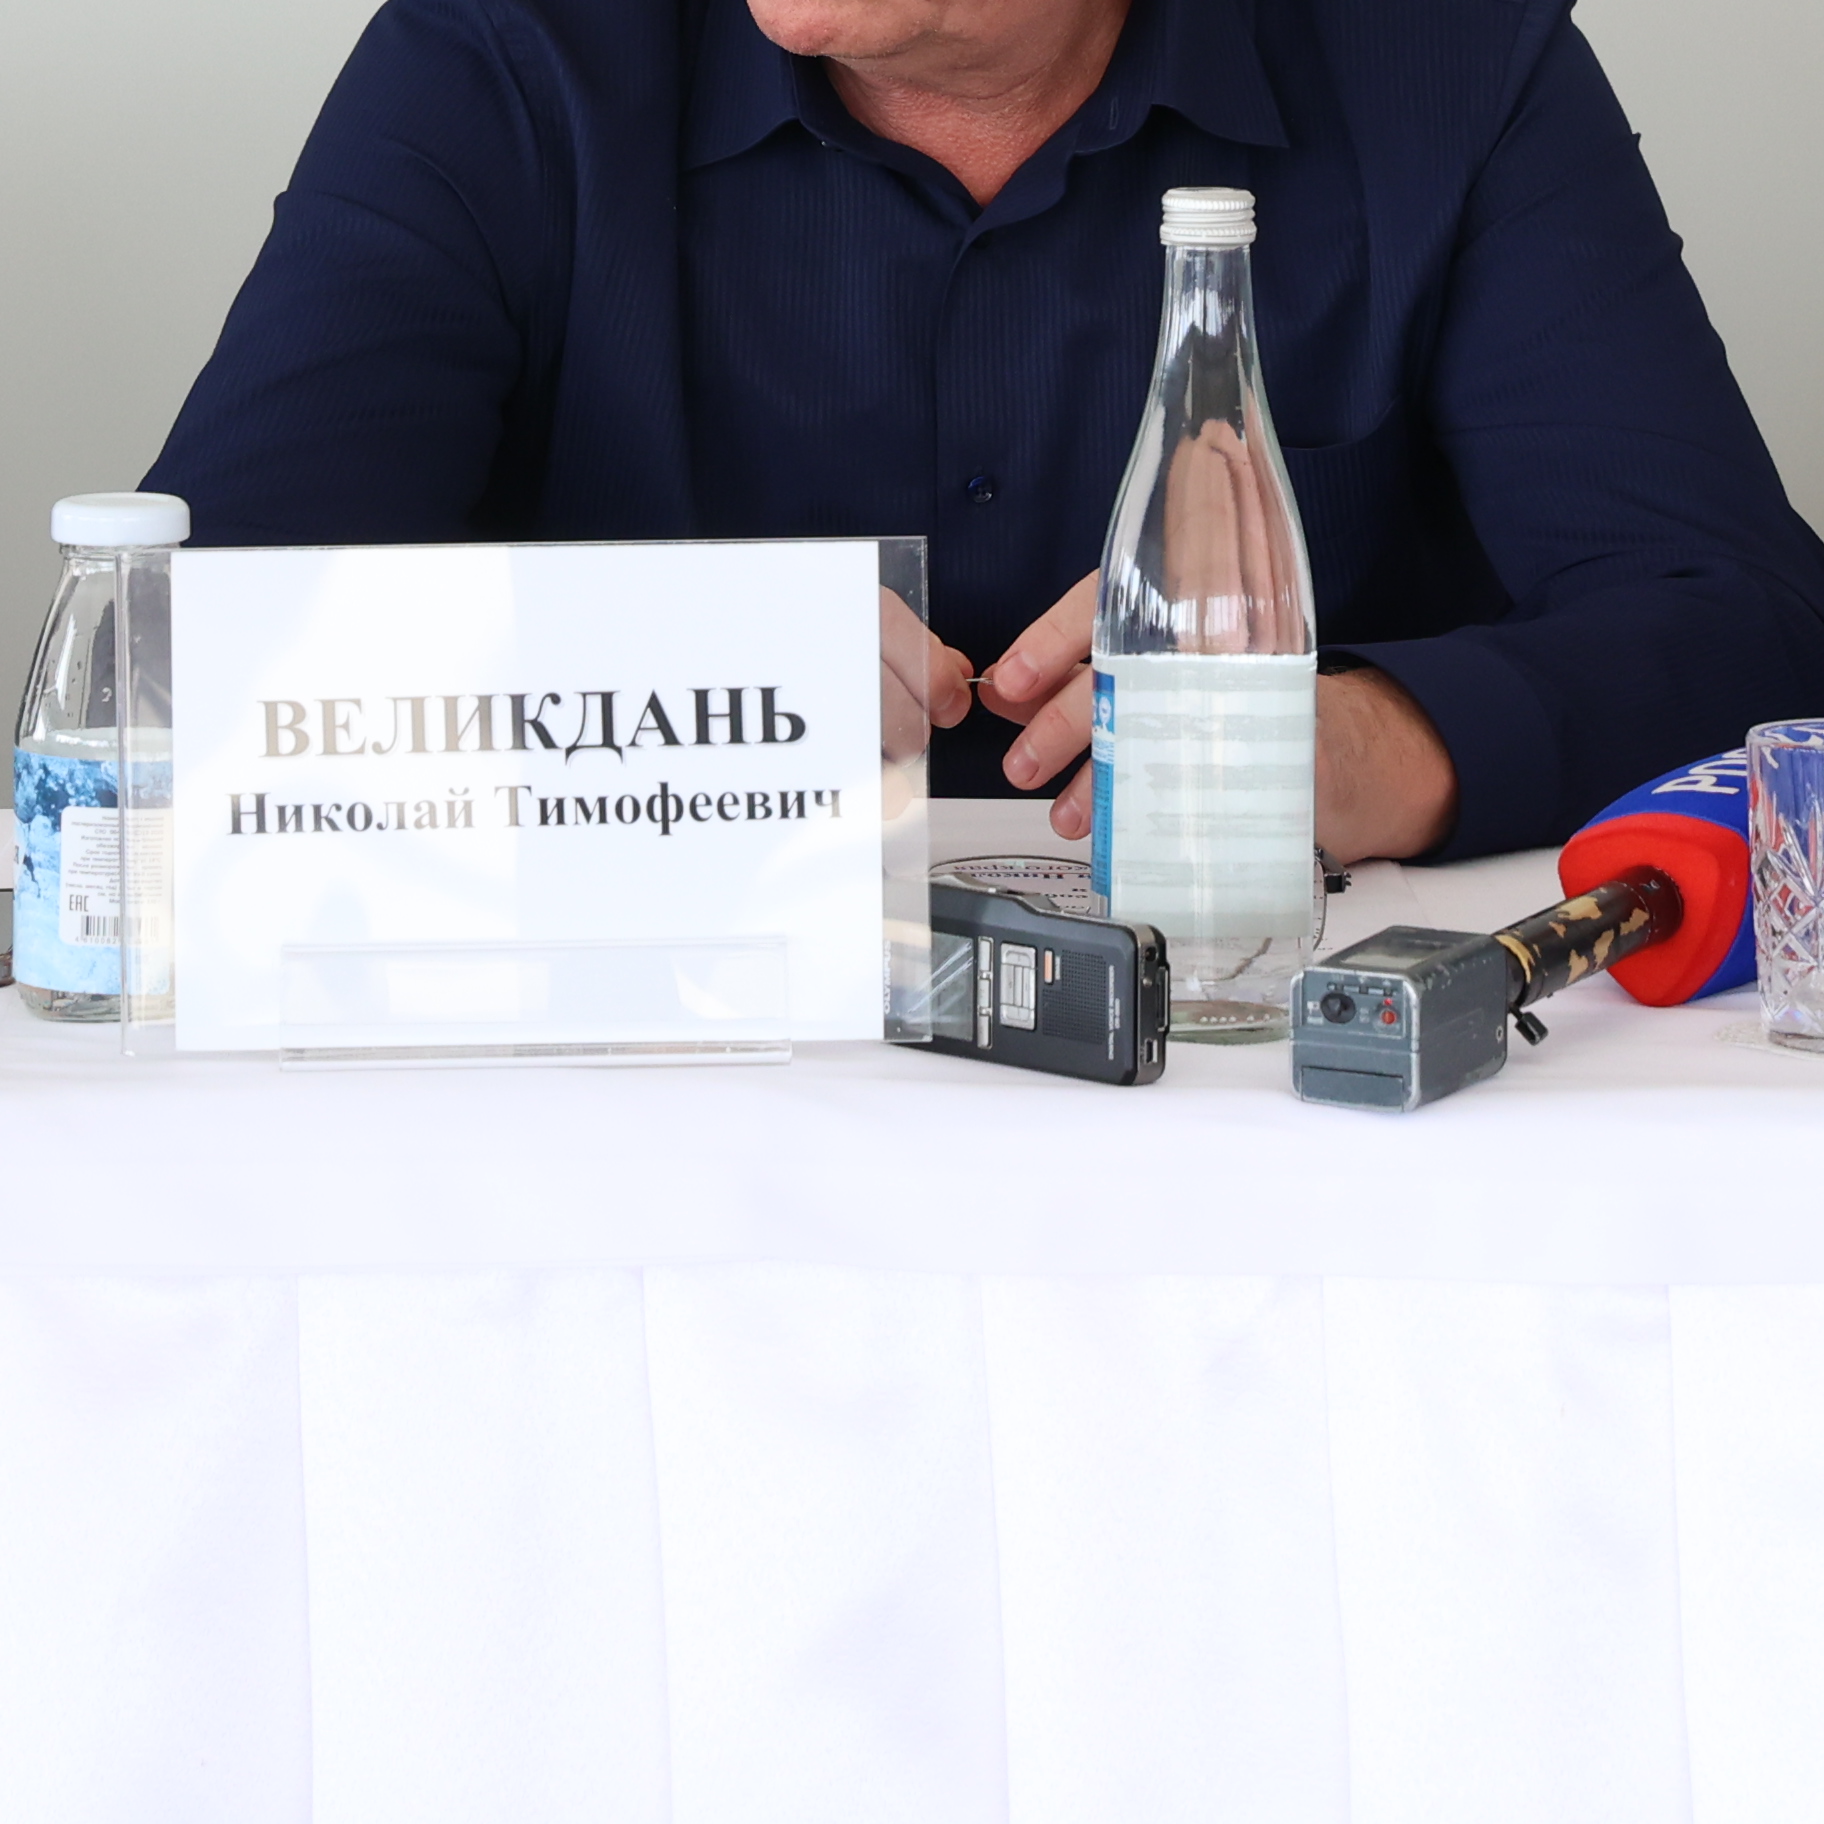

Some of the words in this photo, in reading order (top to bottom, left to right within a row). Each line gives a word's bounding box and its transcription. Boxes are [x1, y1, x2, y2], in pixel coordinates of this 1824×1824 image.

[259, 686, 808, 766] ВЕЛИКДАНЬ
[229, 789, 476, 836] Николай
[495, 781, 843, 837] Тимофеевич
[69, 894, 89, 912] EAC
[883, 940, 892, 1015] OLYMPUS
